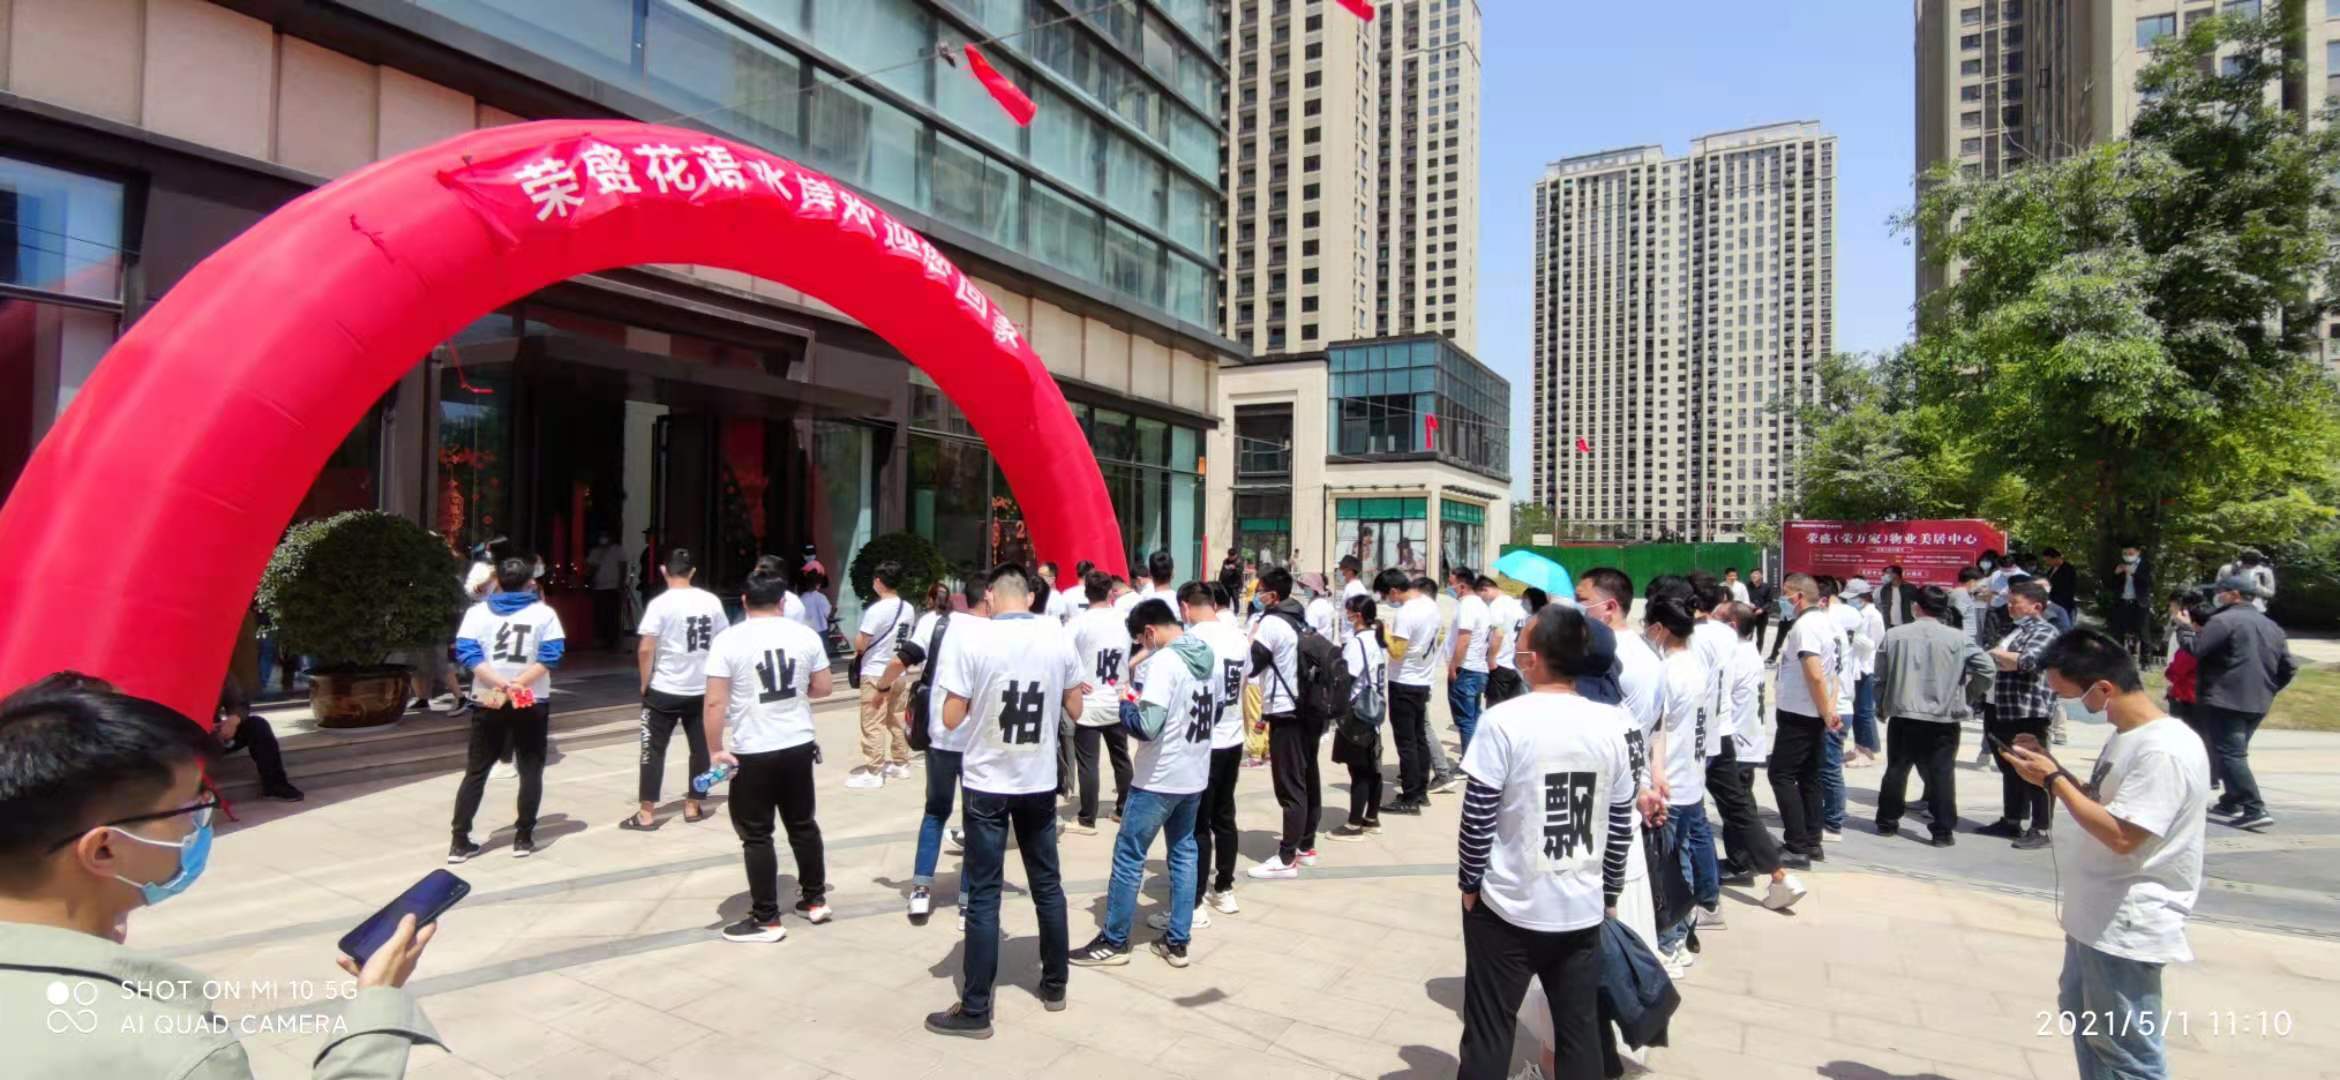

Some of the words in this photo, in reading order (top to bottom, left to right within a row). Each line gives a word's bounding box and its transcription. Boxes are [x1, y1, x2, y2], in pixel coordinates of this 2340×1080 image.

[493, 622, 532, 664] 红
[686, 614, 712, 653] 砖
[755, 648, 797, 704] 业
[1096, 647, 1123, 685] 收
[998, 679, 1045, 745] 柏
[1185, 686, 1214, 744] 油
[1543, 771, 1597, 860] 飘
